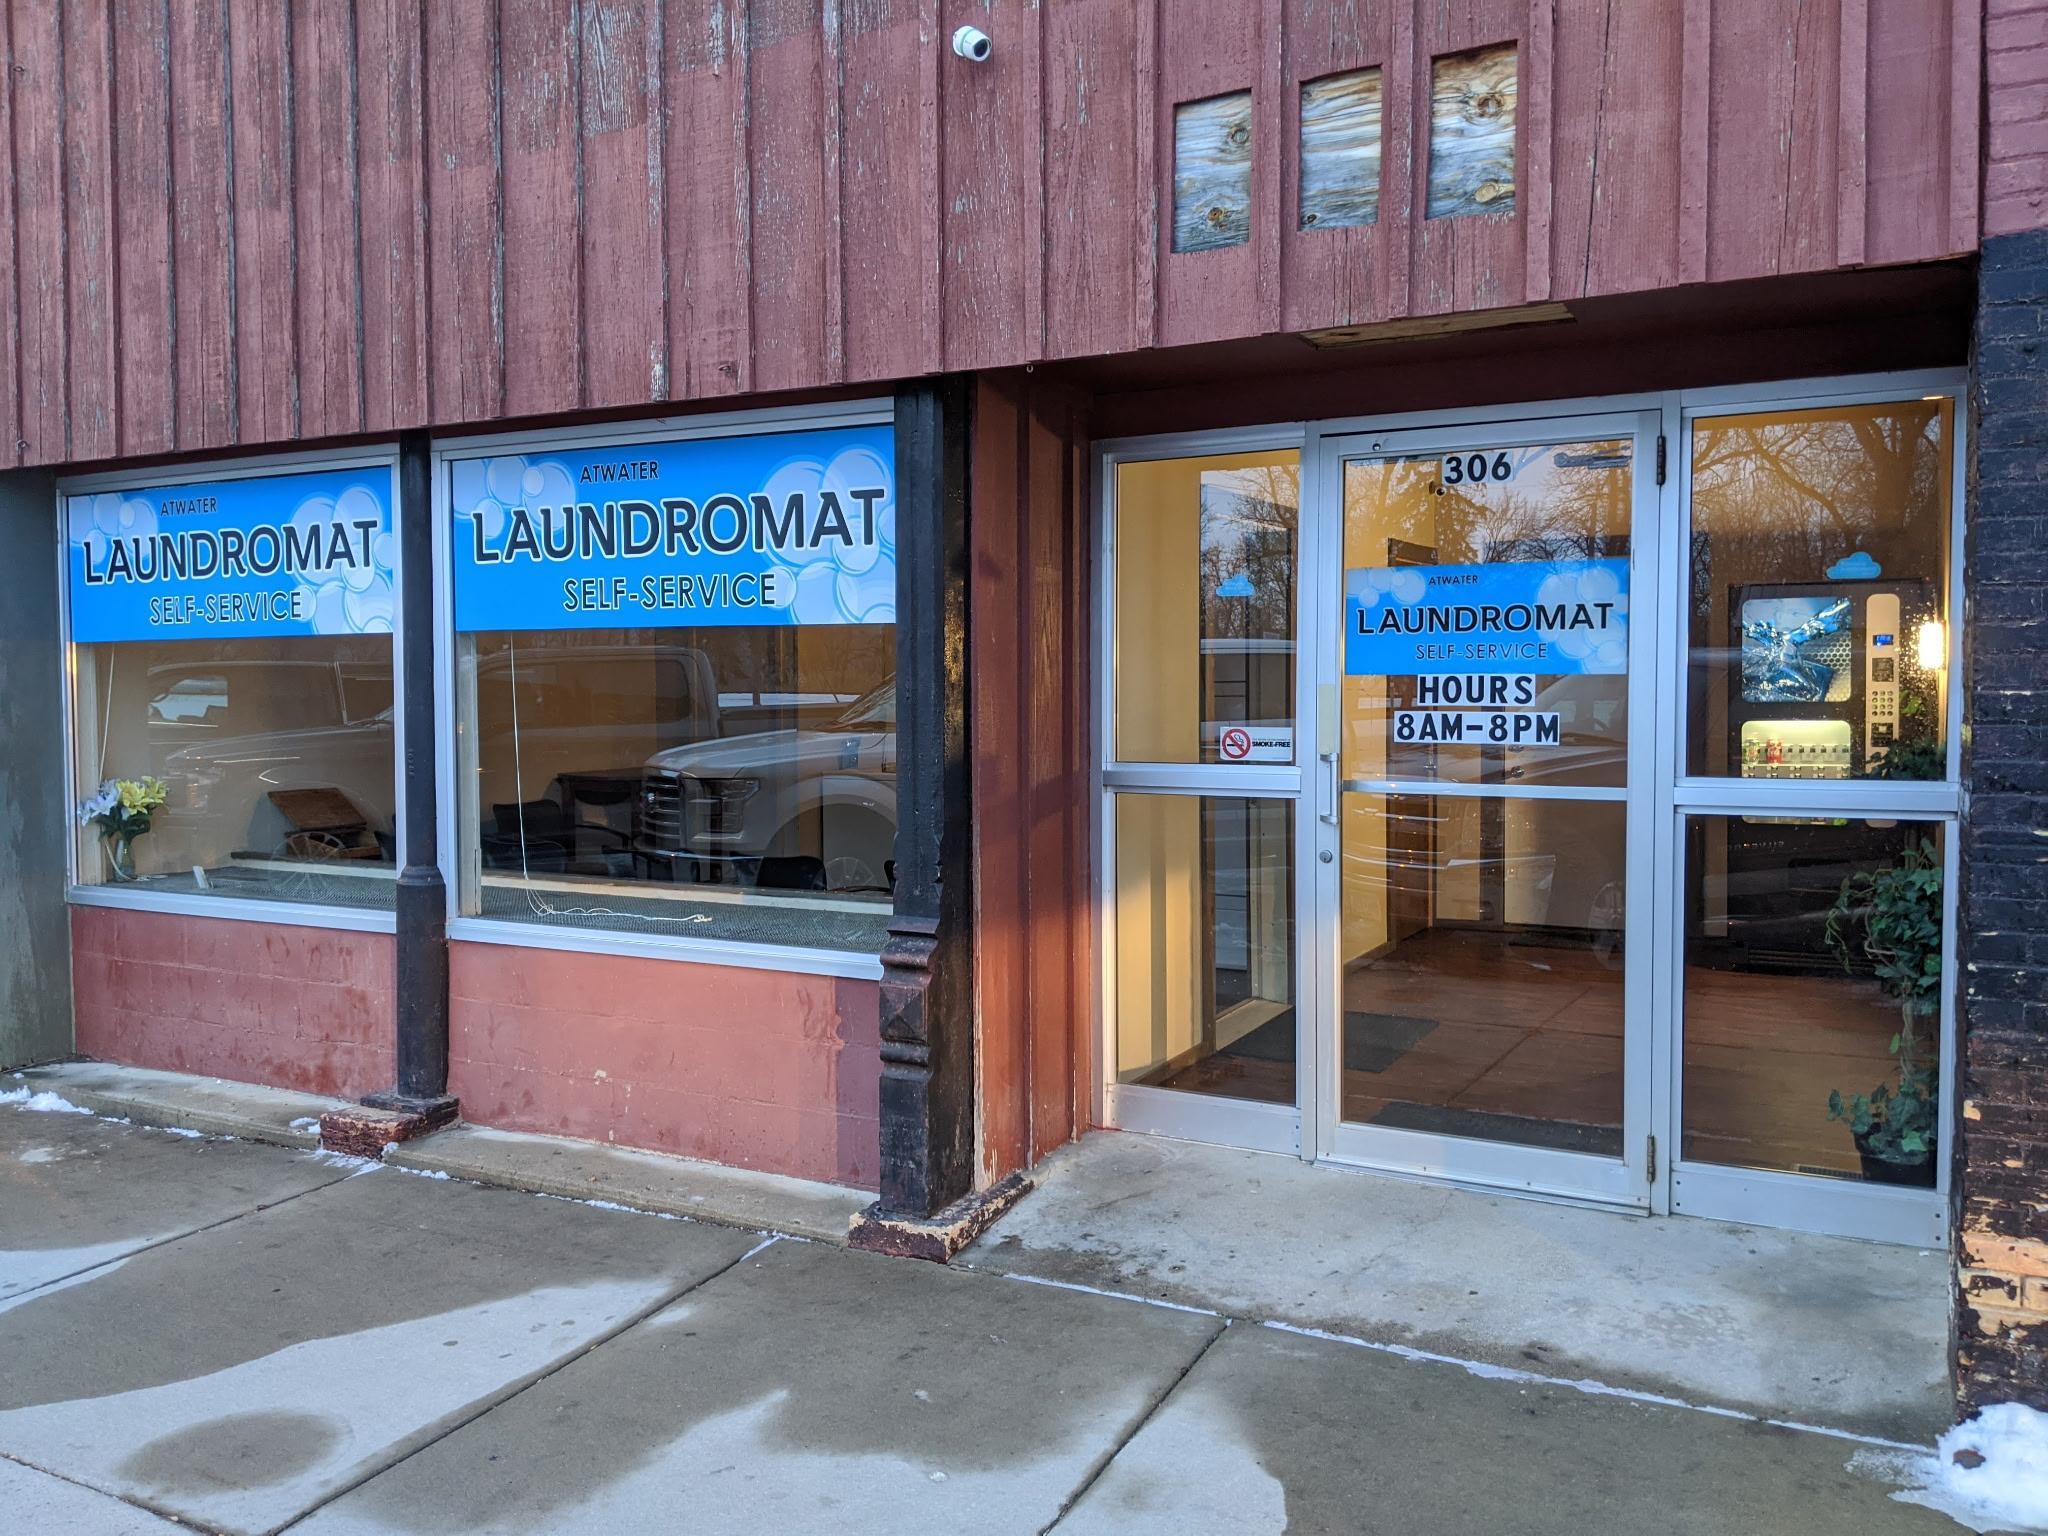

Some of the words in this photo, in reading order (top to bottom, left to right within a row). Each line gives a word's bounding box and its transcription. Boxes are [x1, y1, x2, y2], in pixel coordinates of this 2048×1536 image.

[579, 460, 659, 484] ATWATER
[1444, 452, 1512, 484] 306
[159, 497, 217, 518] ATWATER
[471, 488, 886, 563] LAUNDROMAT
[82, 519, 378, 585] LAUNDROMAT
[562, 571, 777, 612] SELF-SERVICE
[1428, 574, 1479, 586] ATWATER
[149, 590, 303, 626] SELF-SERVICE
[1356, 602, 1614, 636] LAUNDROMAT
[1416, 642, 1548, 660] SELF-SERVICE
[1418, 675, 1533, 705] HOURS
